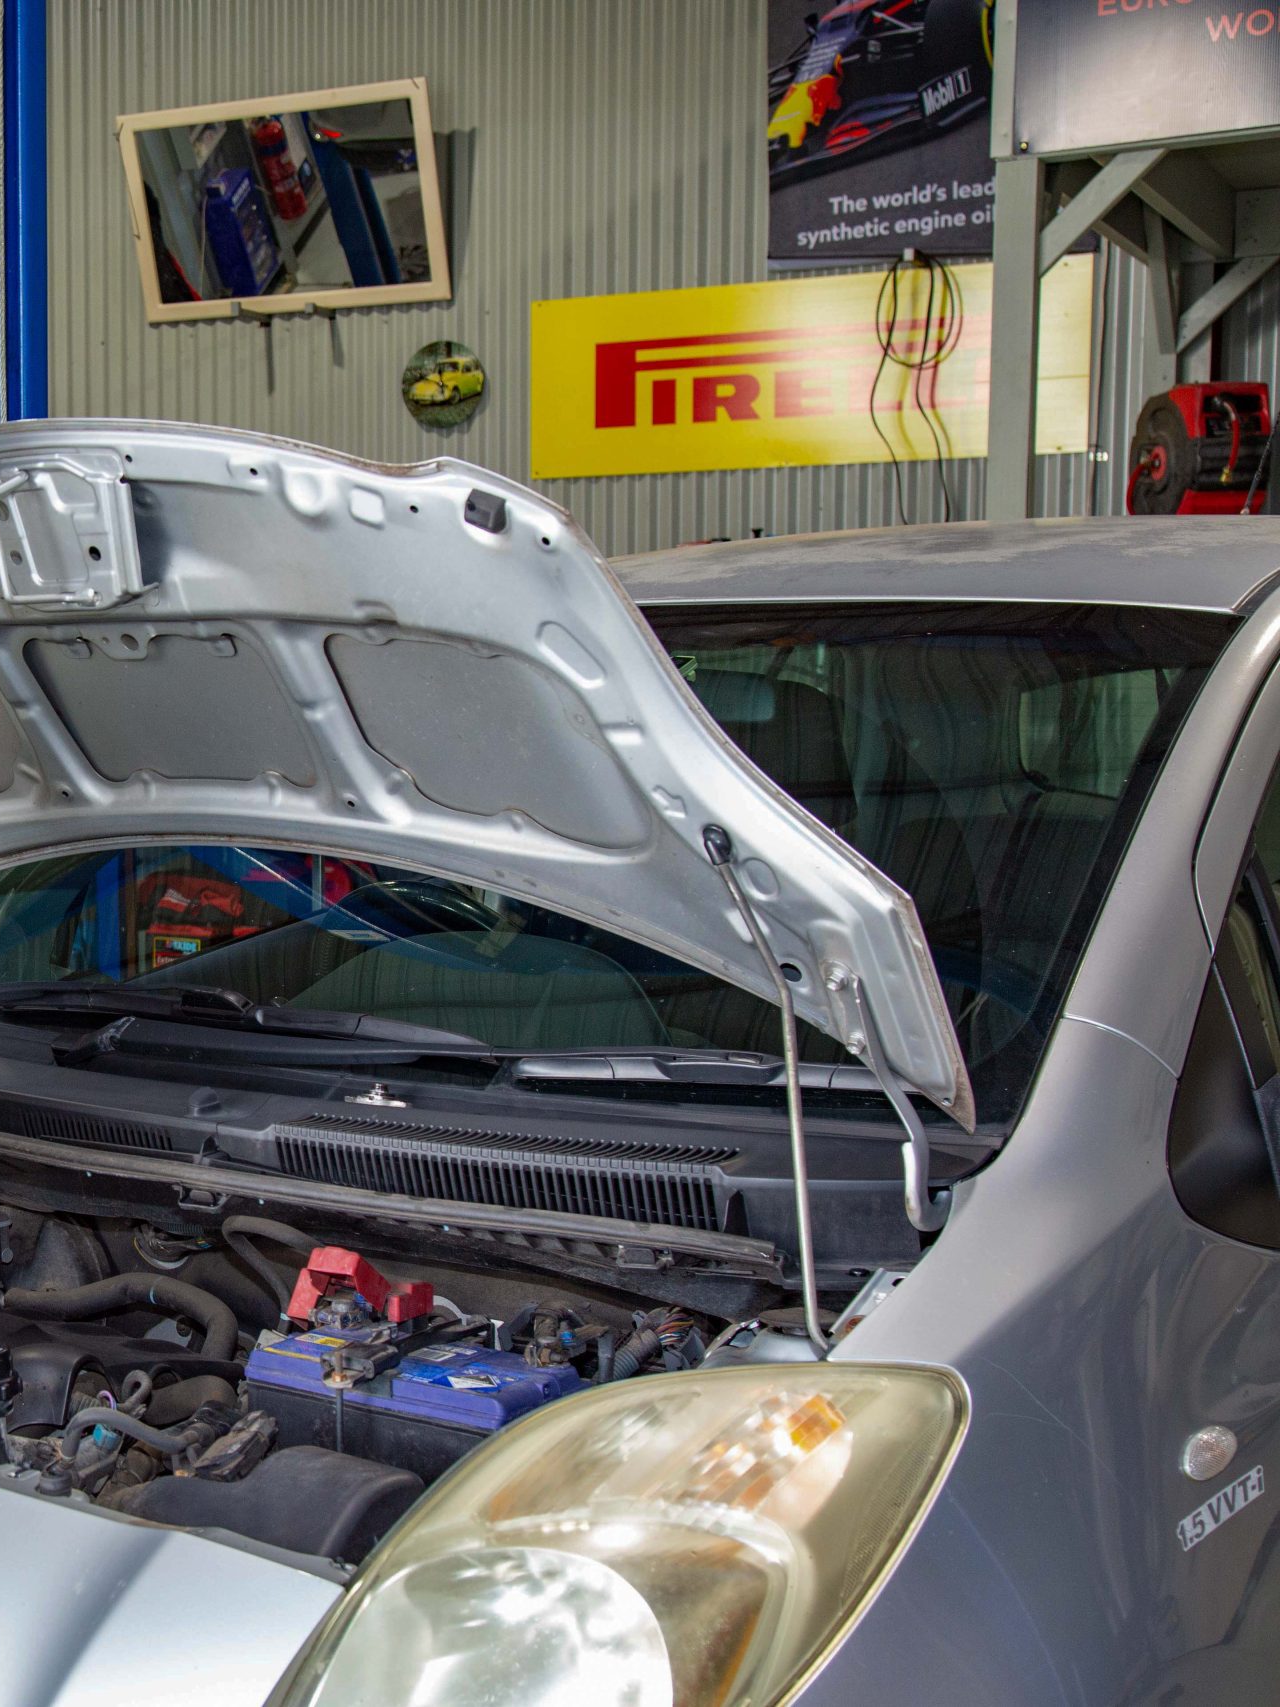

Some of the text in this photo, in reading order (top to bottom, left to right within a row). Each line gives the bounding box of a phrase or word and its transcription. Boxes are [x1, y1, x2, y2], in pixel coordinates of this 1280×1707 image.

[1205, 9, 1280, 42] WO
[921, 72, 956, 116] Mobil
[829, 195, 868, 215] The
[872, 184, 948, 209] world's
[796, 219, 890, 250] synthetic
[894, 209, 967, 237] engine
[1179, 1467, 1264, 1547] 1.5 VVT-i
